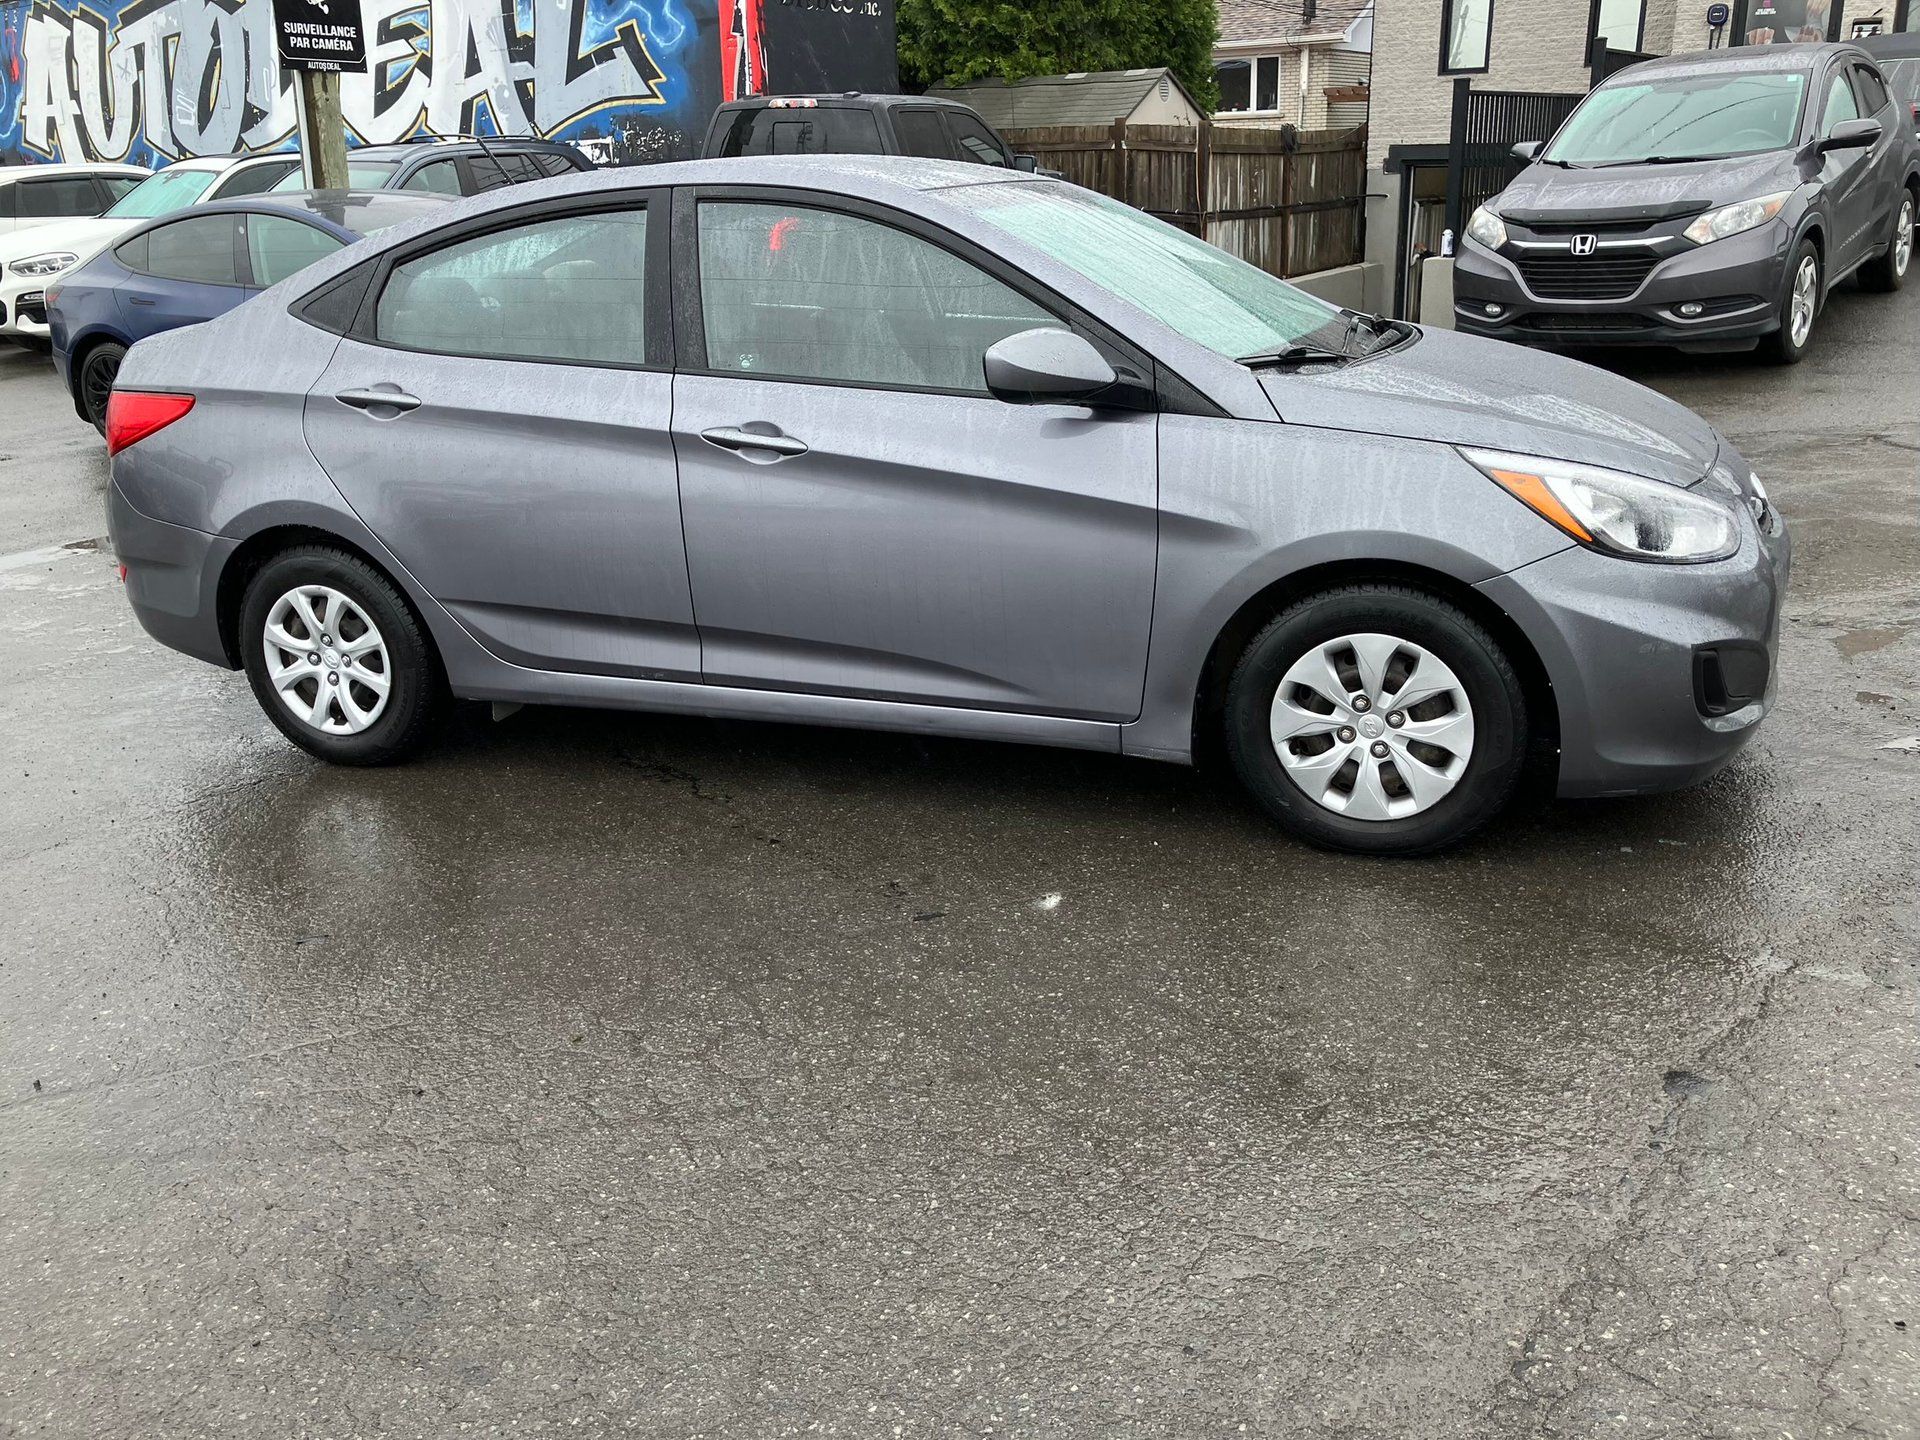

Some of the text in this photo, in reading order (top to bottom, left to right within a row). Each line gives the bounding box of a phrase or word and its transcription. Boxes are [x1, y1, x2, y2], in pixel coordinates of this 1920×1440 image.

[283, 21, 357, 38] SURVEILLANCE
[290, 36, 354, 51] PAR CAMÉRA
